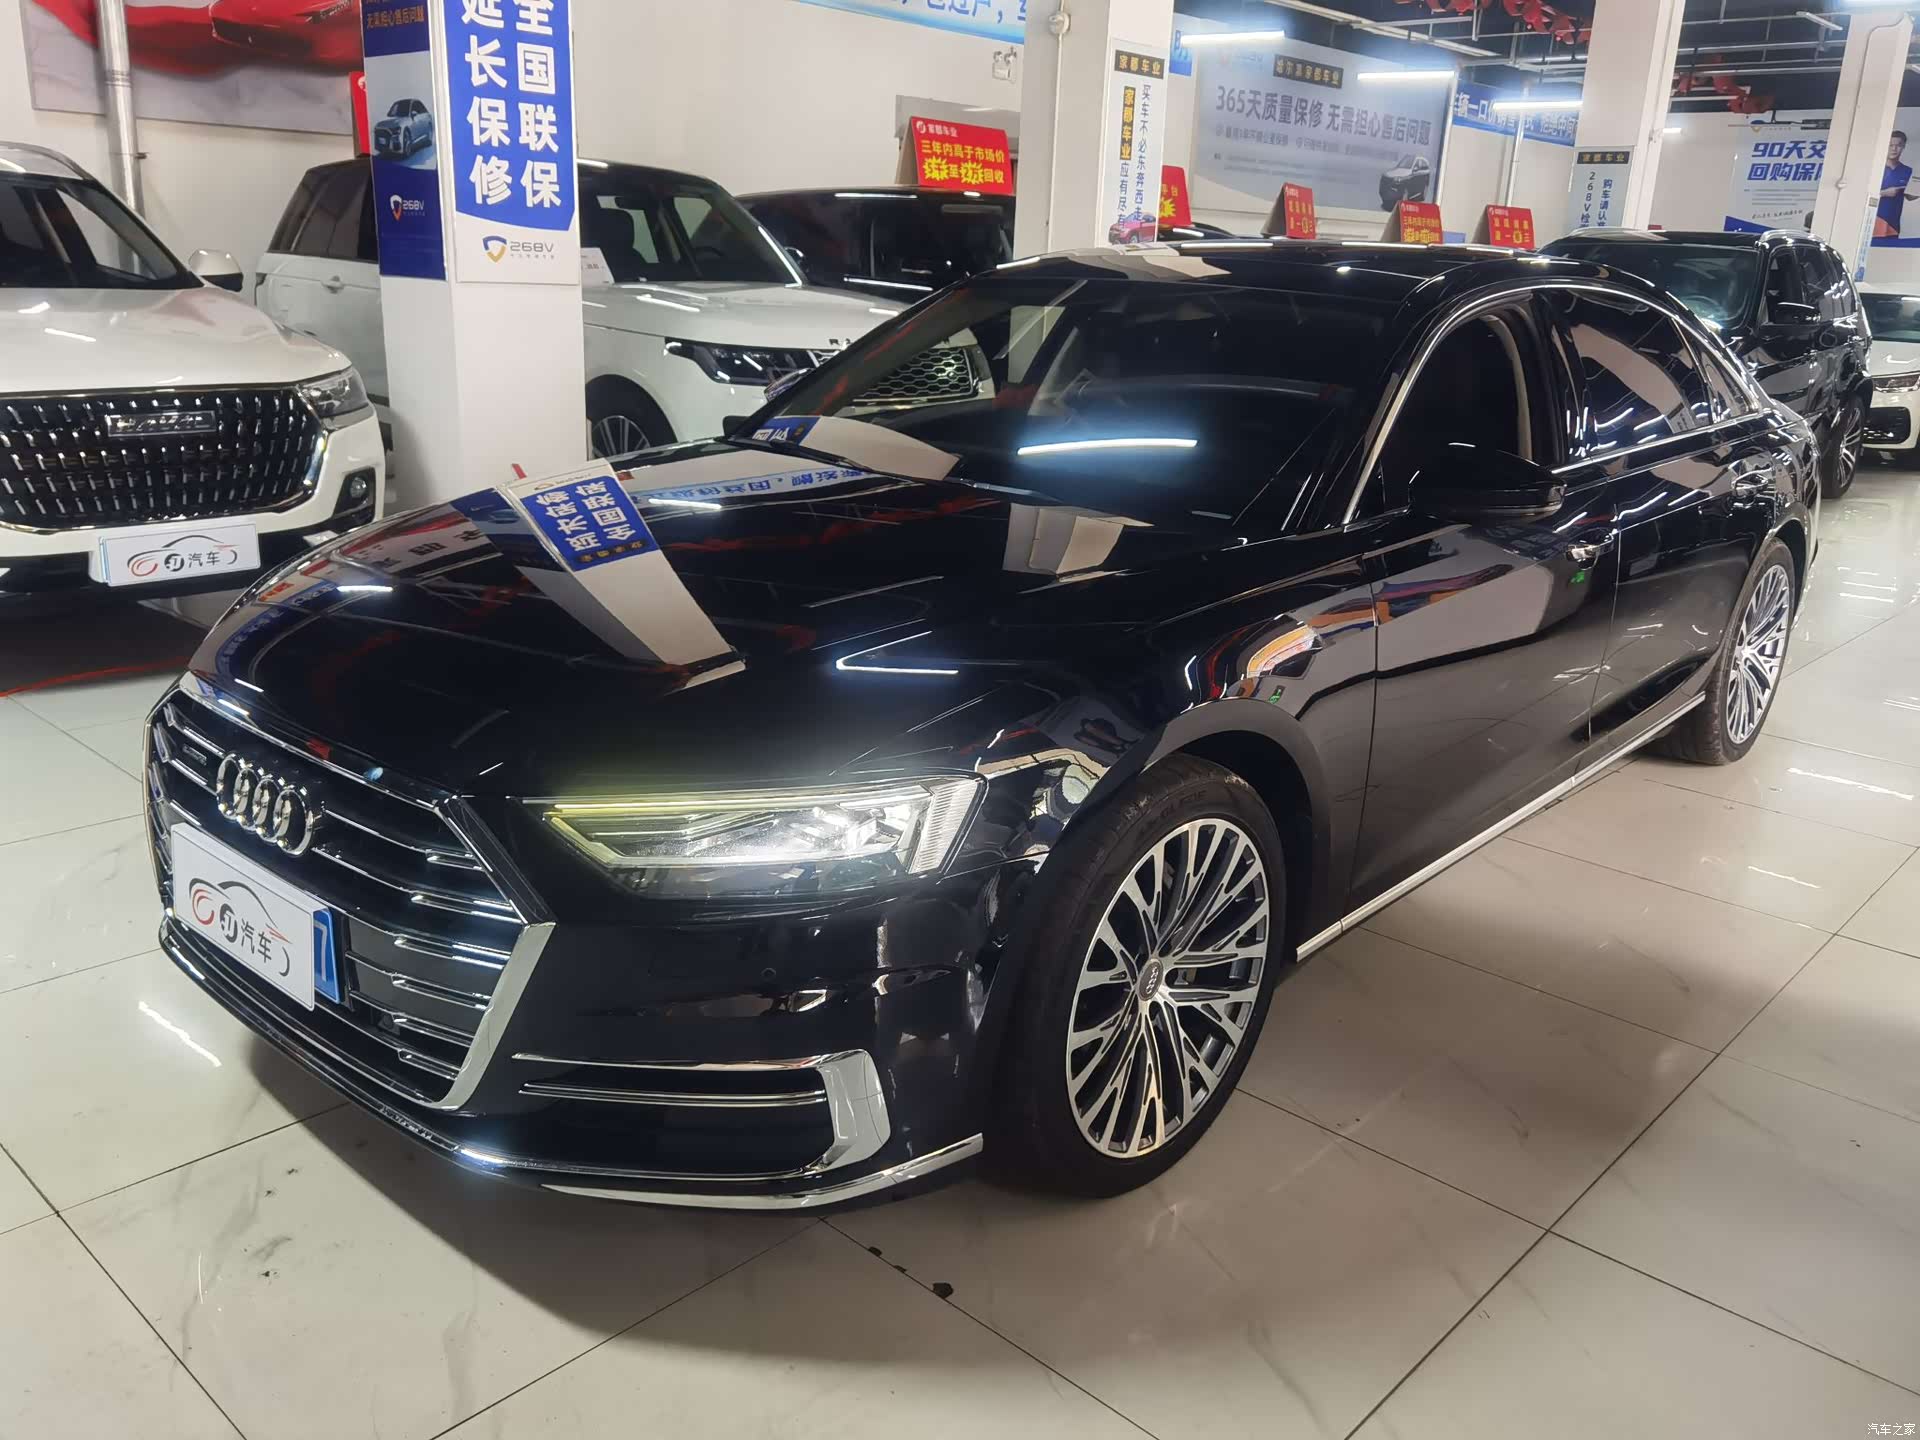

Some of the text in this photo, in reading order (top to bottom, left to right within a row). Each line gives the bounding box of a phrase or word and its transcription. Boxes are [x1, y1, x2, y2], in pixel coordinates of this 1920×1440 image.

[461, 0, 512, 205] 延长保修
[515, 0, 562, 208] 全国联保
[1216, 86, 1432, 146] 365天质量保修 无需担心售后问题
[921, 139, 1005, 163] 三年内高于市场价
[1132, 84, 1152, 222] 买车不必东奔西走
[510, 241, 554, 253] 268V
[187, 551, 221, 567] 汽车
[241, 926, 272, 964] 汽车
